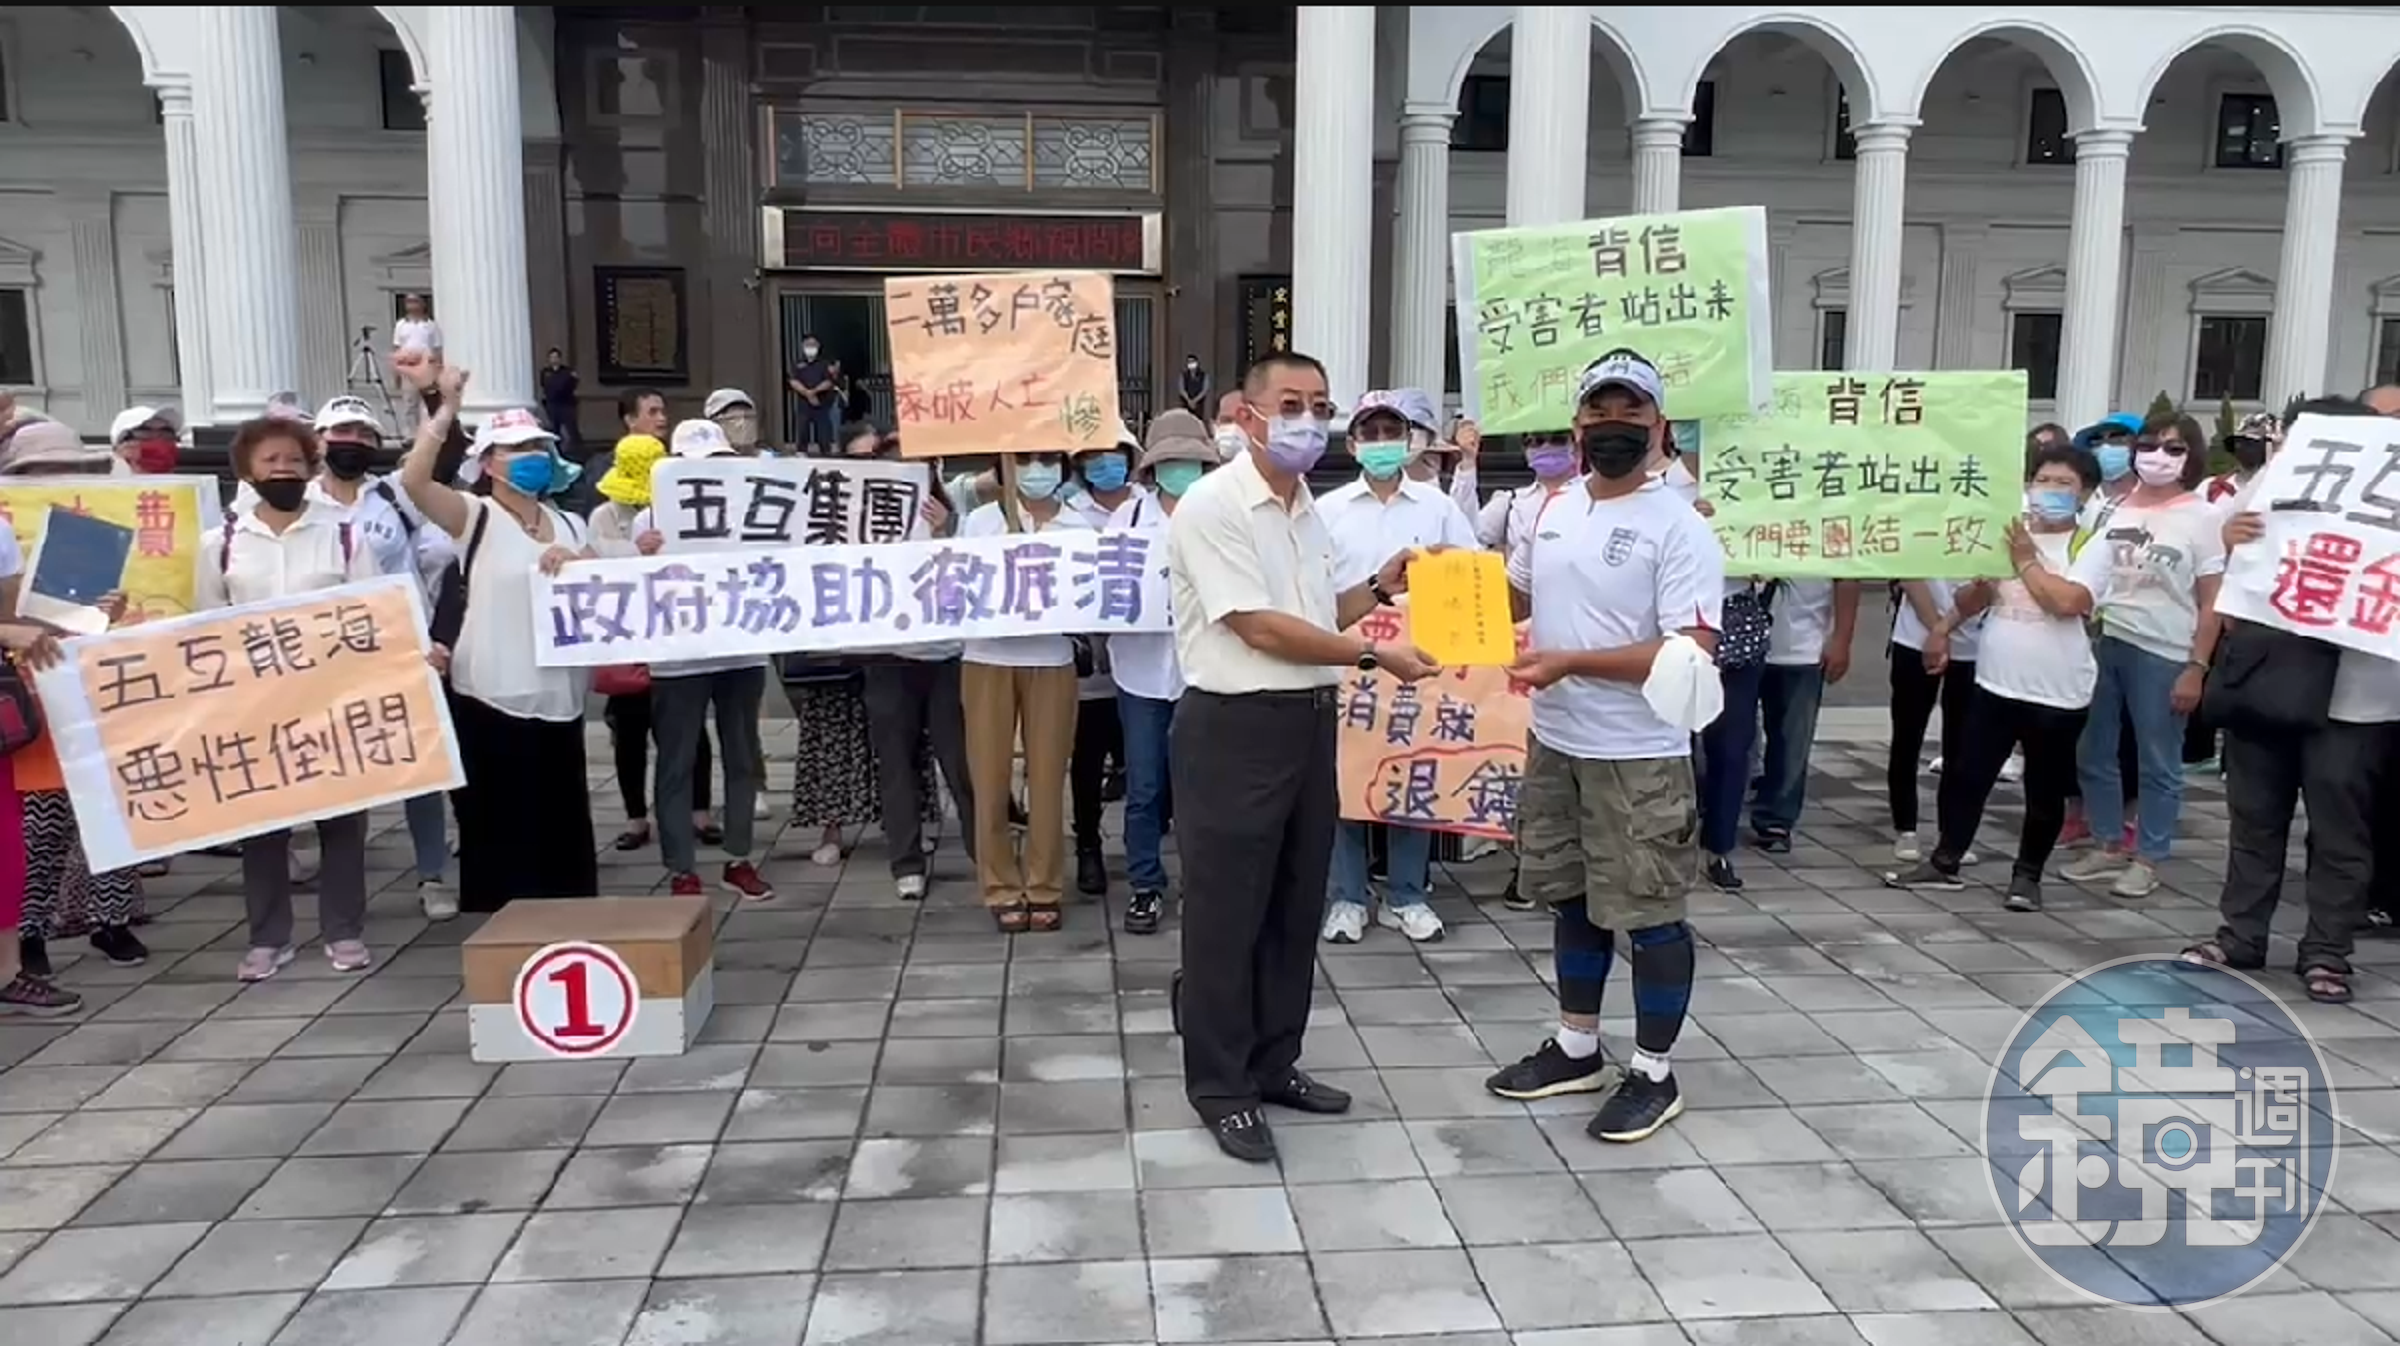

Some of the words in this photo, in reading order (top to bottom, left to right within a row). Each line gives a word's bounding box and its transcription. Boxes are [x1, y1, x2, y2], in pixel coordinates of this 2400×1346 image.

[1588, 224, 1687, 277] 背信
[1826, 377, 1926, 426] 背信
[677, 467, 918, 545] 五互集團
[98, 603, 382, 713] 五互龍海
[548, 961, 606, 1037] 1
